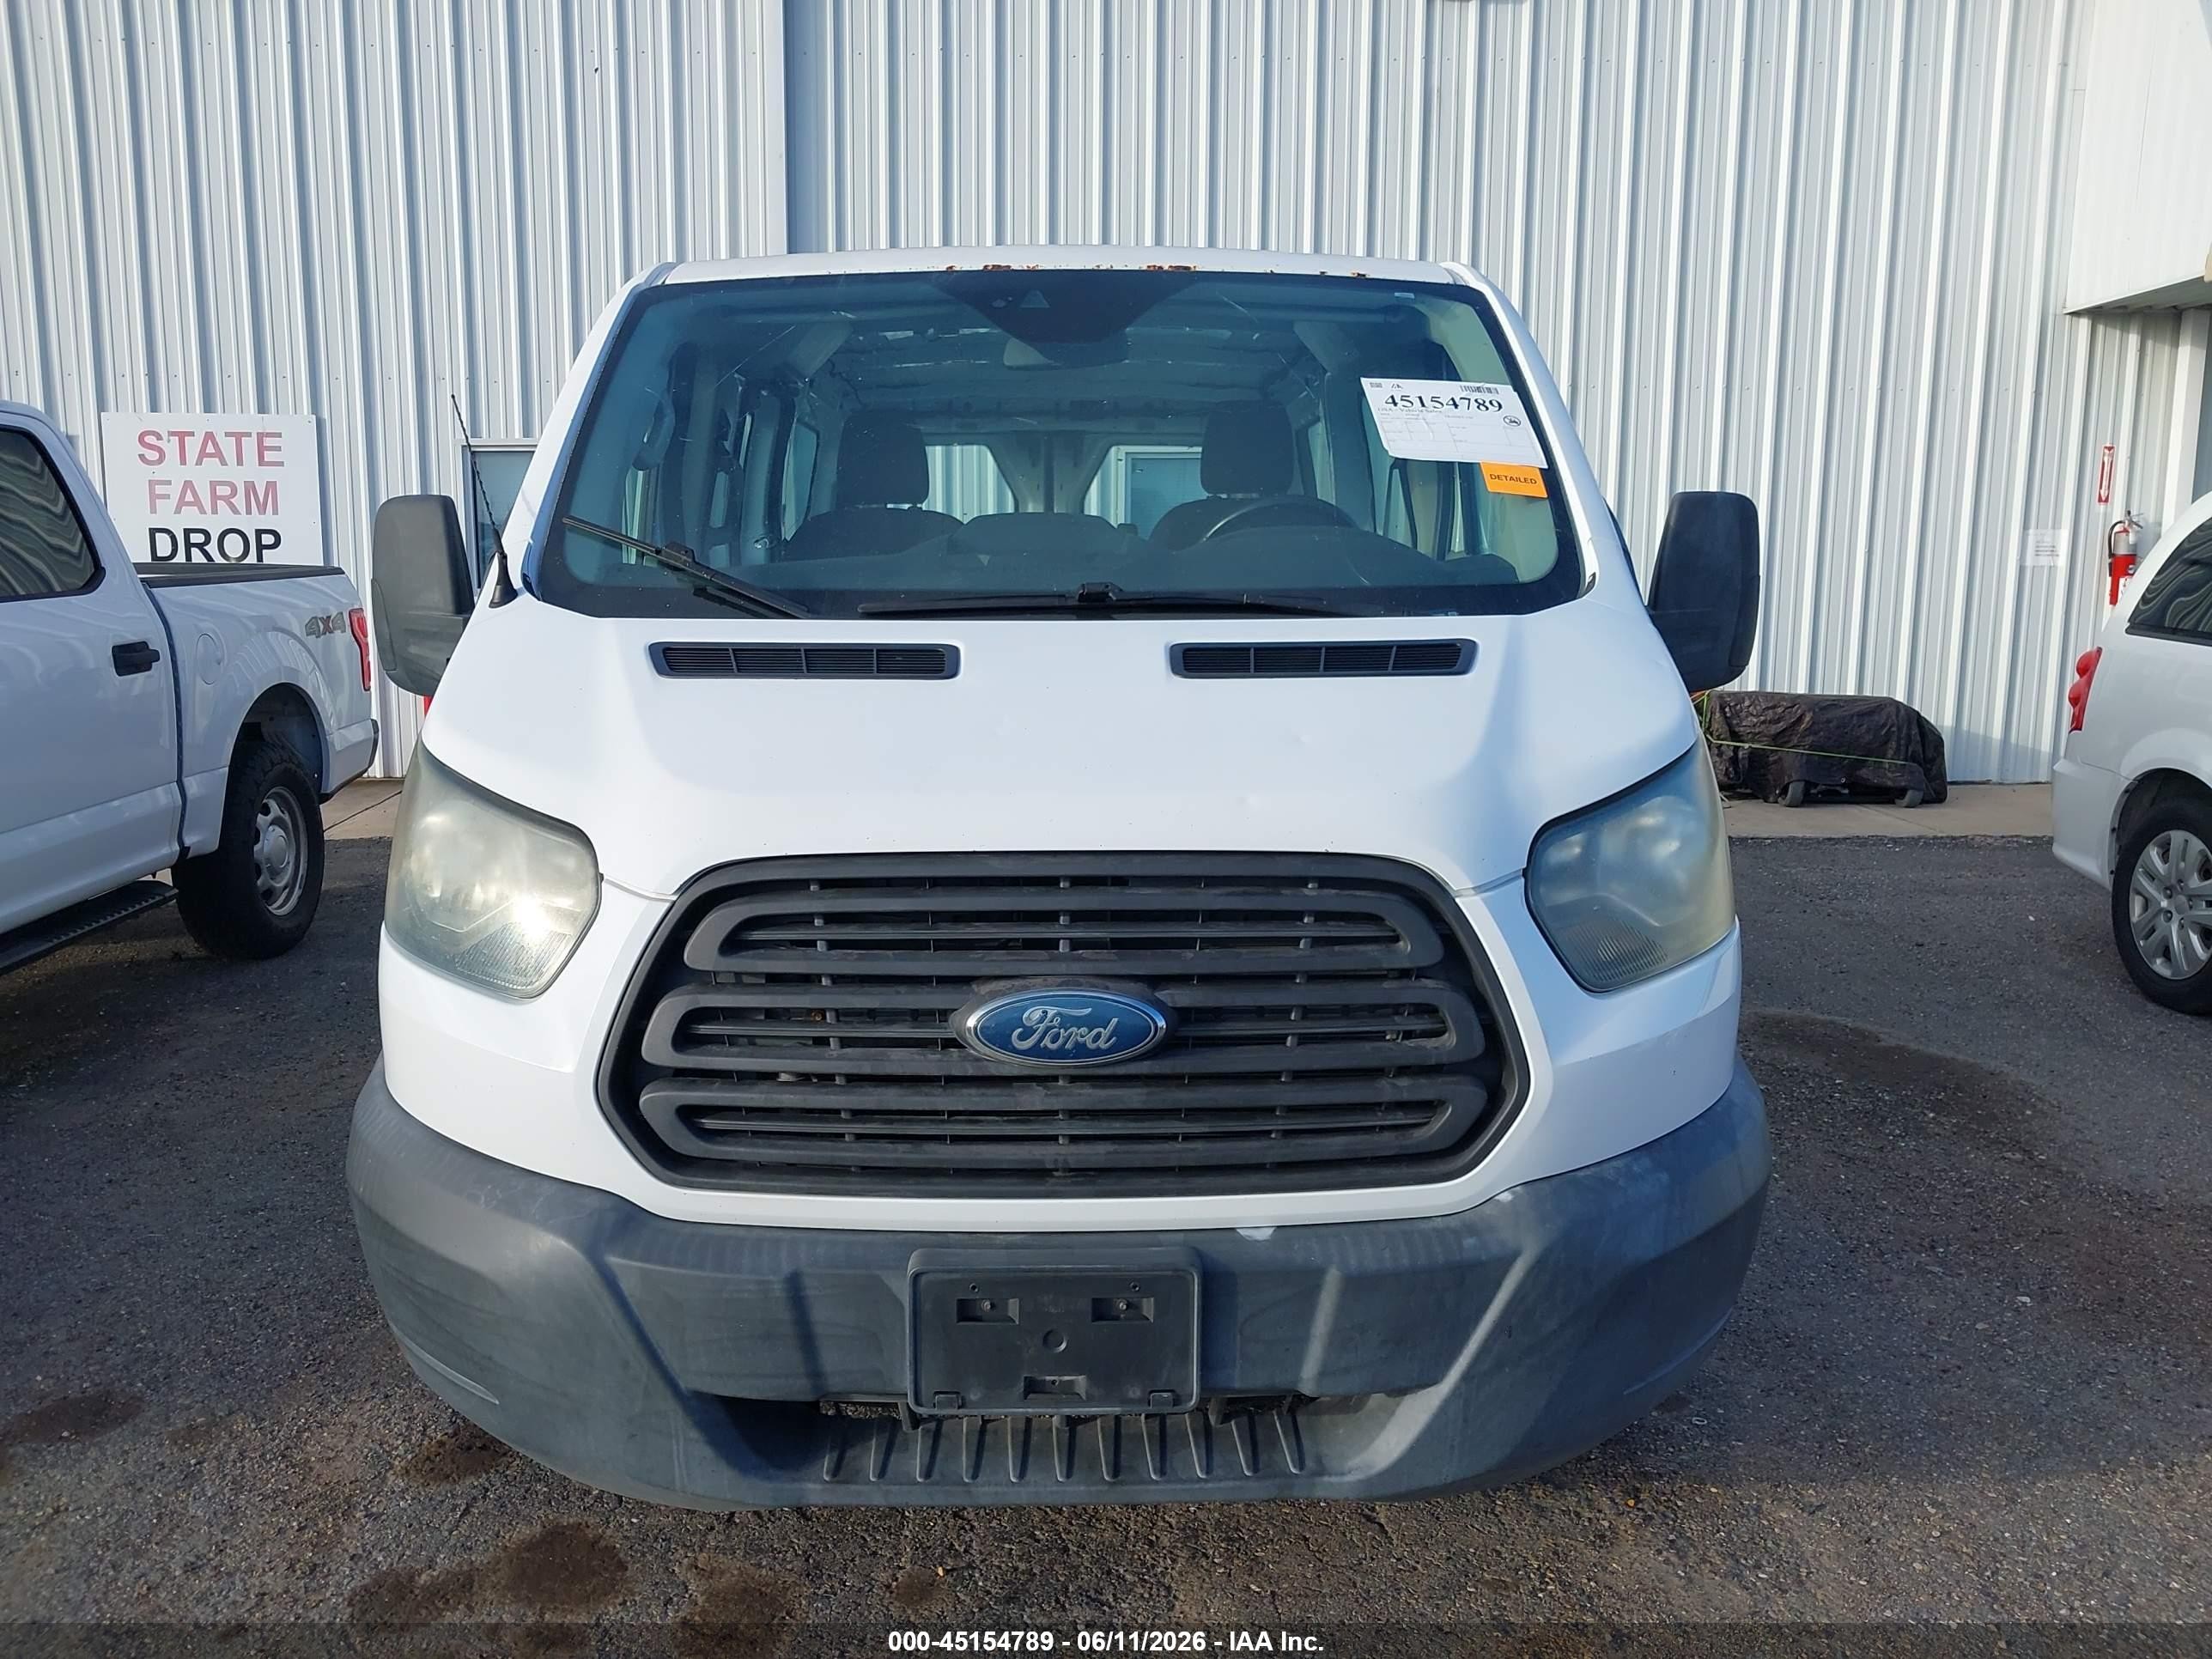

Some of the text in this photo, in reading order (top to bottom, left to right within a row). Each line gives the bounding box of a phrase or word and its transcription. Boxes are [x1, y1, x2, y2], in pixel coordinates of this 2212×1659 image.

[1385, 394, 1503, 412] 45154789
[137, 429, 285, 467] STATE
[1489, 473, 1538, 484] DETAILED
[148, 479, 279, 515] FARM
[148, 527, 282, 563] DROP
[1012, 1006, 1120, 1051] Ford
